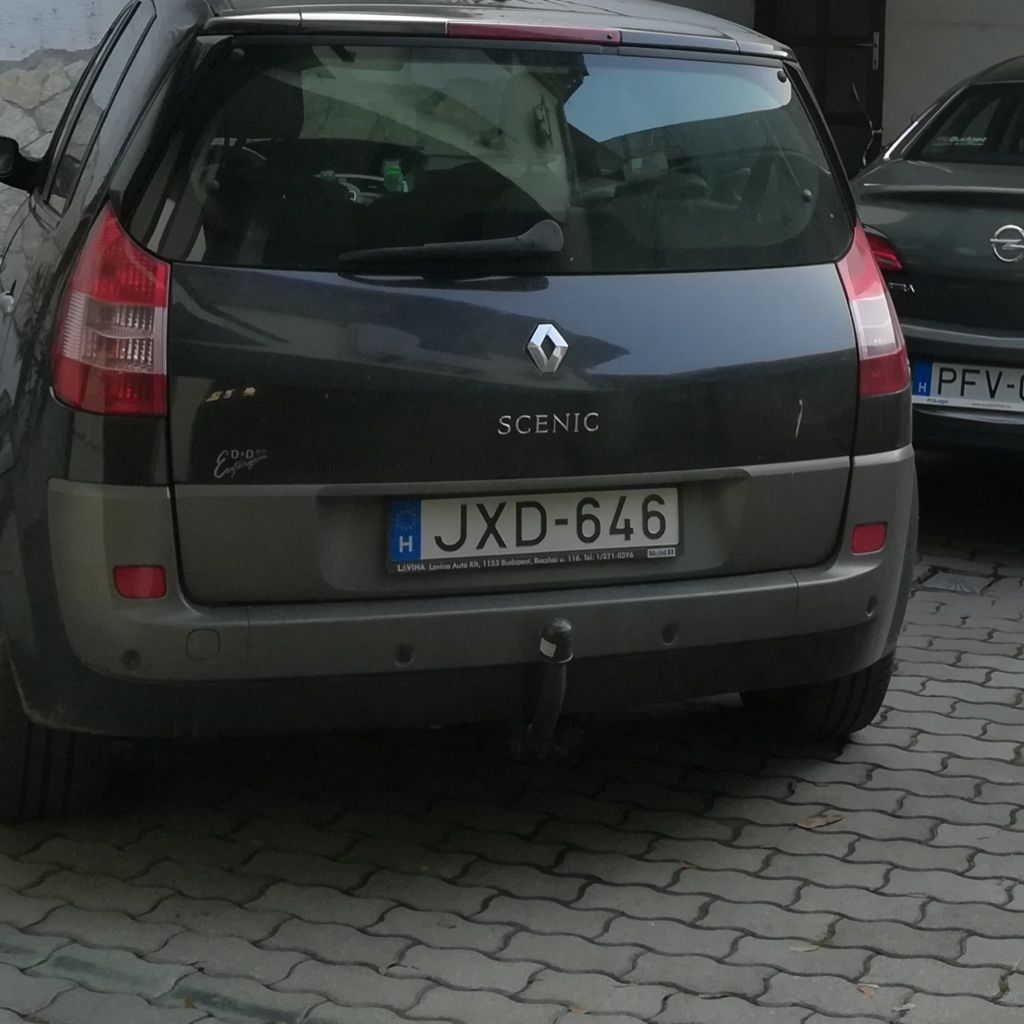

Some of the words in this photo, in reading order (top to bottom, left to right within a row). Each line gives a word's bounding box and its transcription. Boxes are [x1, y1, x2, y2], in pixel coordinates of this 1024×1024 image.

[918, 382, 927, 394] H
[497, 412, 600, 435] SCENIC
[399, 535, 413, 553] H
[433, 494, 667, 552] JXD-646
